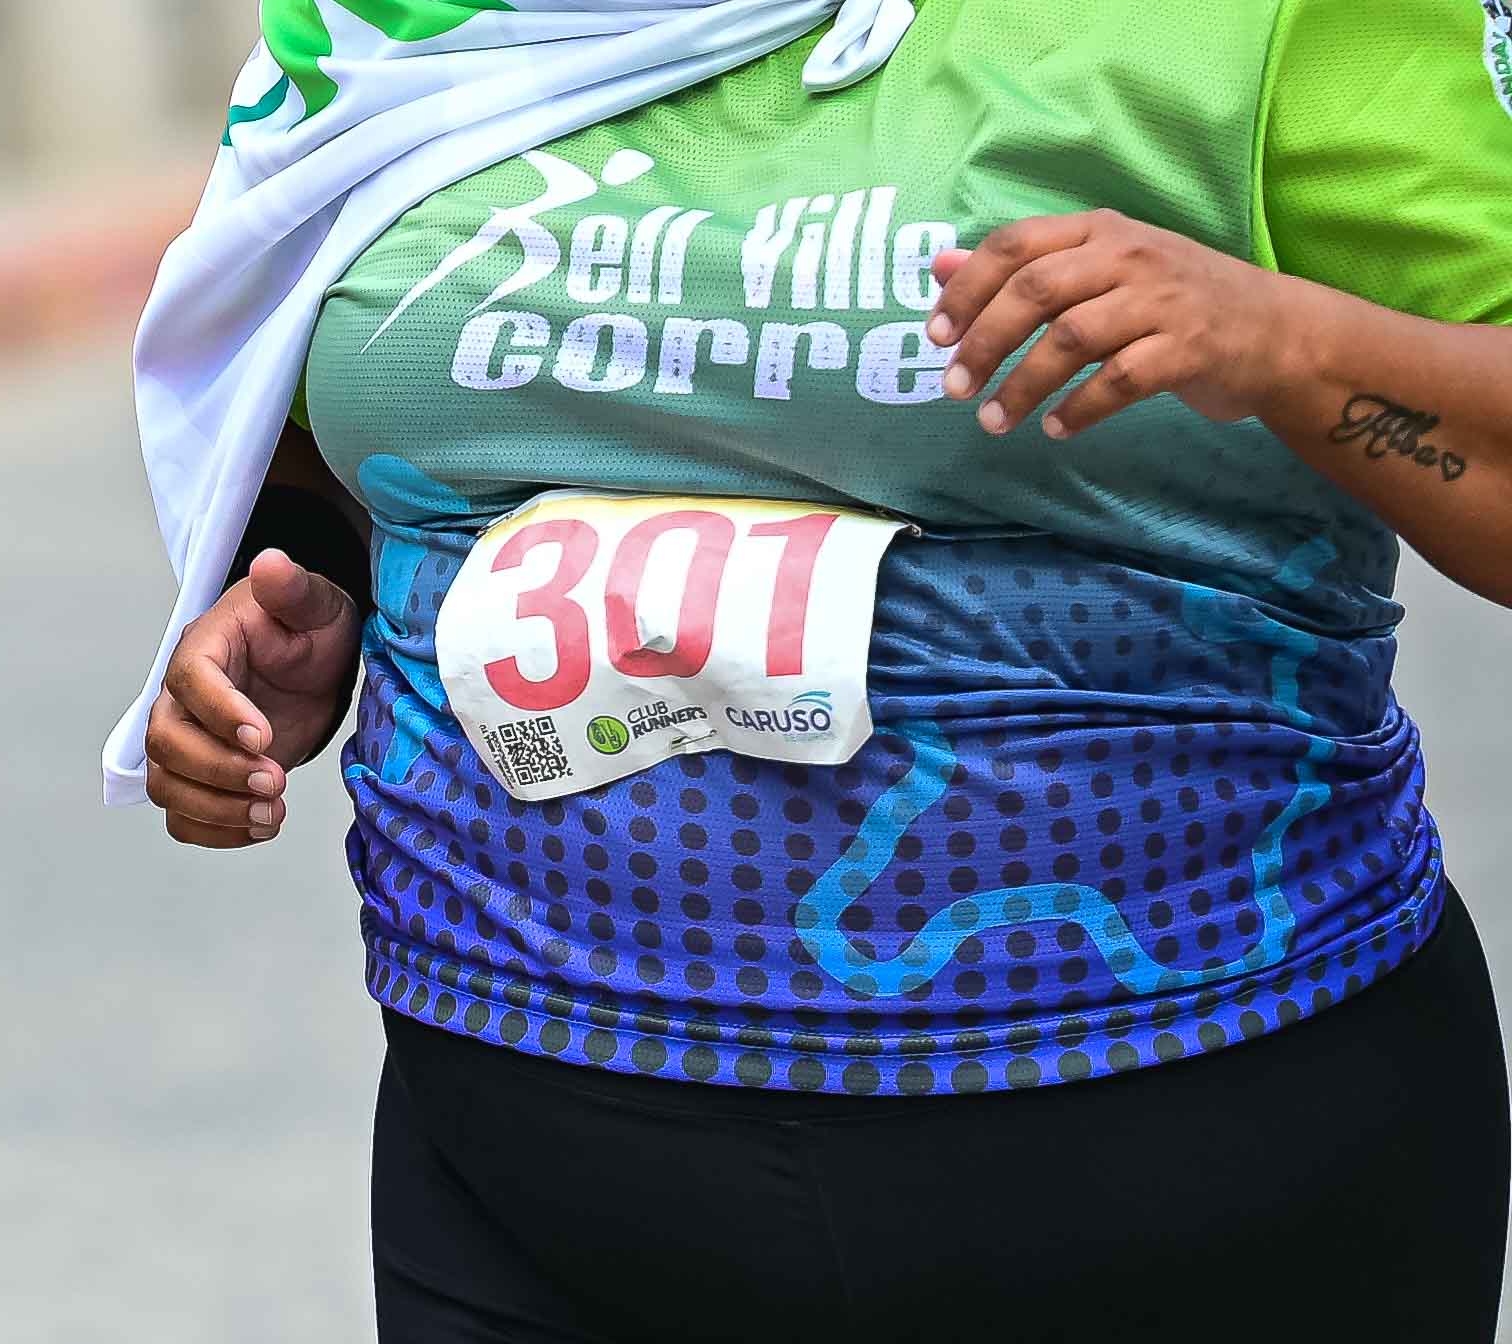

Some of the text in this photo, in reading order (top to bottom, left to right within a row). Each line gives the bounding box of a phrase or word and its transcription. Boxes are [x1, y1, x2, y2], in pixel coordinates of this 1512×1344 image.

[741, 185, 958, 309] Ville
[450, 311, 946, 405] corre
[484, 510, 840, 711] 301
[627, 701, 668, 724] CLUB
[726, 706, 831, 733] CARUSO
